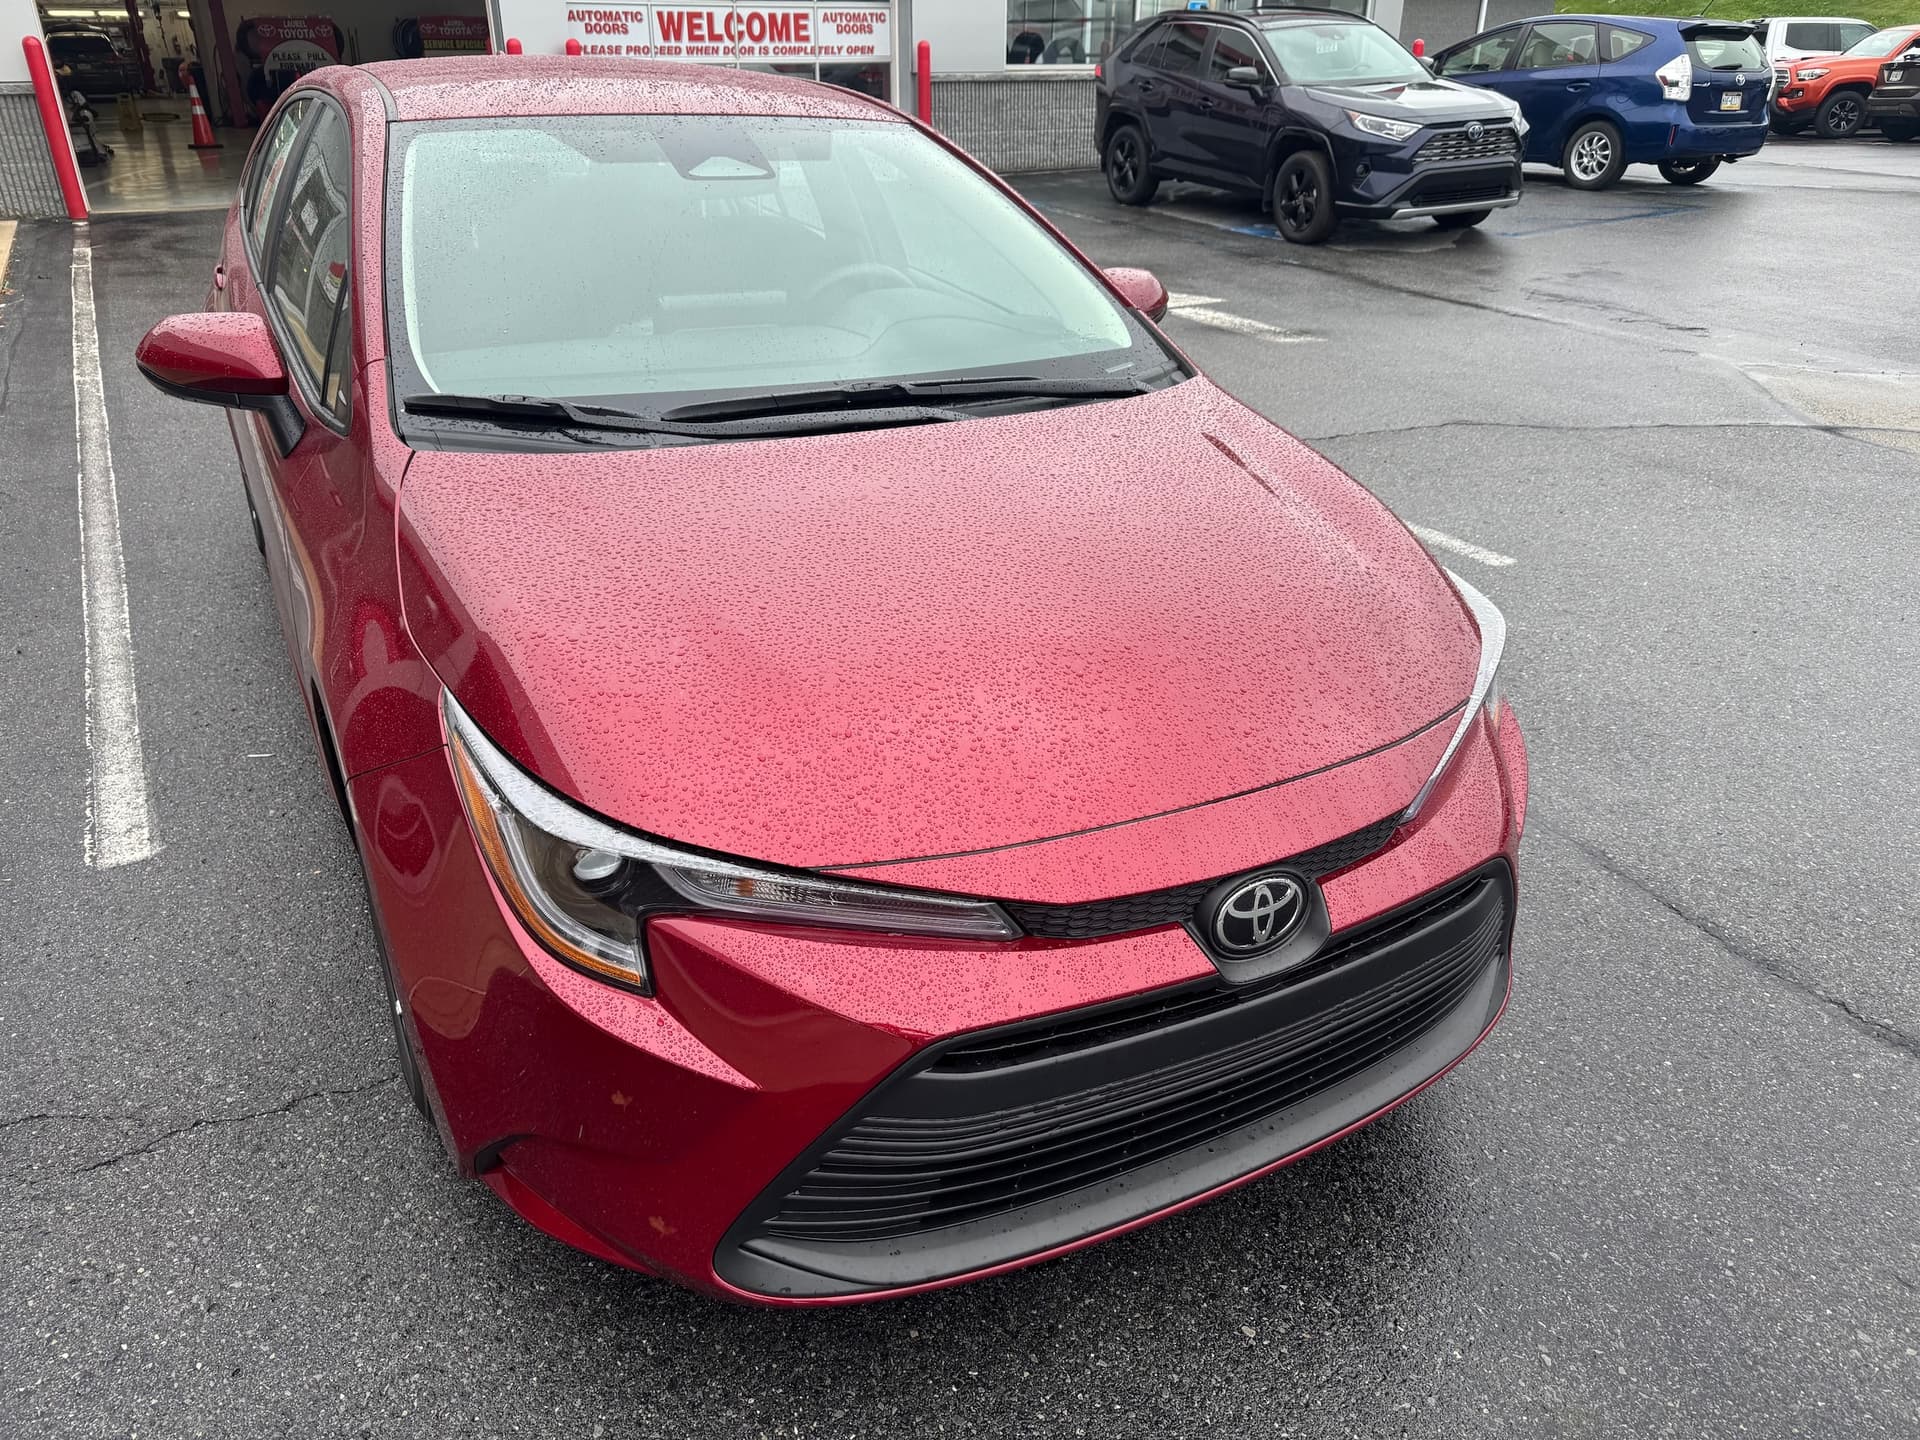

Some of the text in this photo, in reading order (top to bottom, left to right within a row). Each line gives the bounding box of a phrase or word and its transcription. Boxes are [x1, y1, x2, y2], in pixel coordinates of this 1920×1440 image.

[568, 10, 643, 22] AUTOMATIC
[822, 12, 886, 23] AUTOMATIC
[439, 26, 472, 35] TOYOTA
[585, 23, 629, 34] DOORS
[656, 11, 811, 43] WELCOME
[836, 24, 873, 34] DOORS
[278, 28, 316, 38] TOYOTA
[686, 46, 719, 55] WHEN
[723, 46, 755, 55] DOOR
[759, 46, 769, 55] IS
[773, 46, 843, 55] COMPLETELY
[846, 46, 875, 55] OPEN
